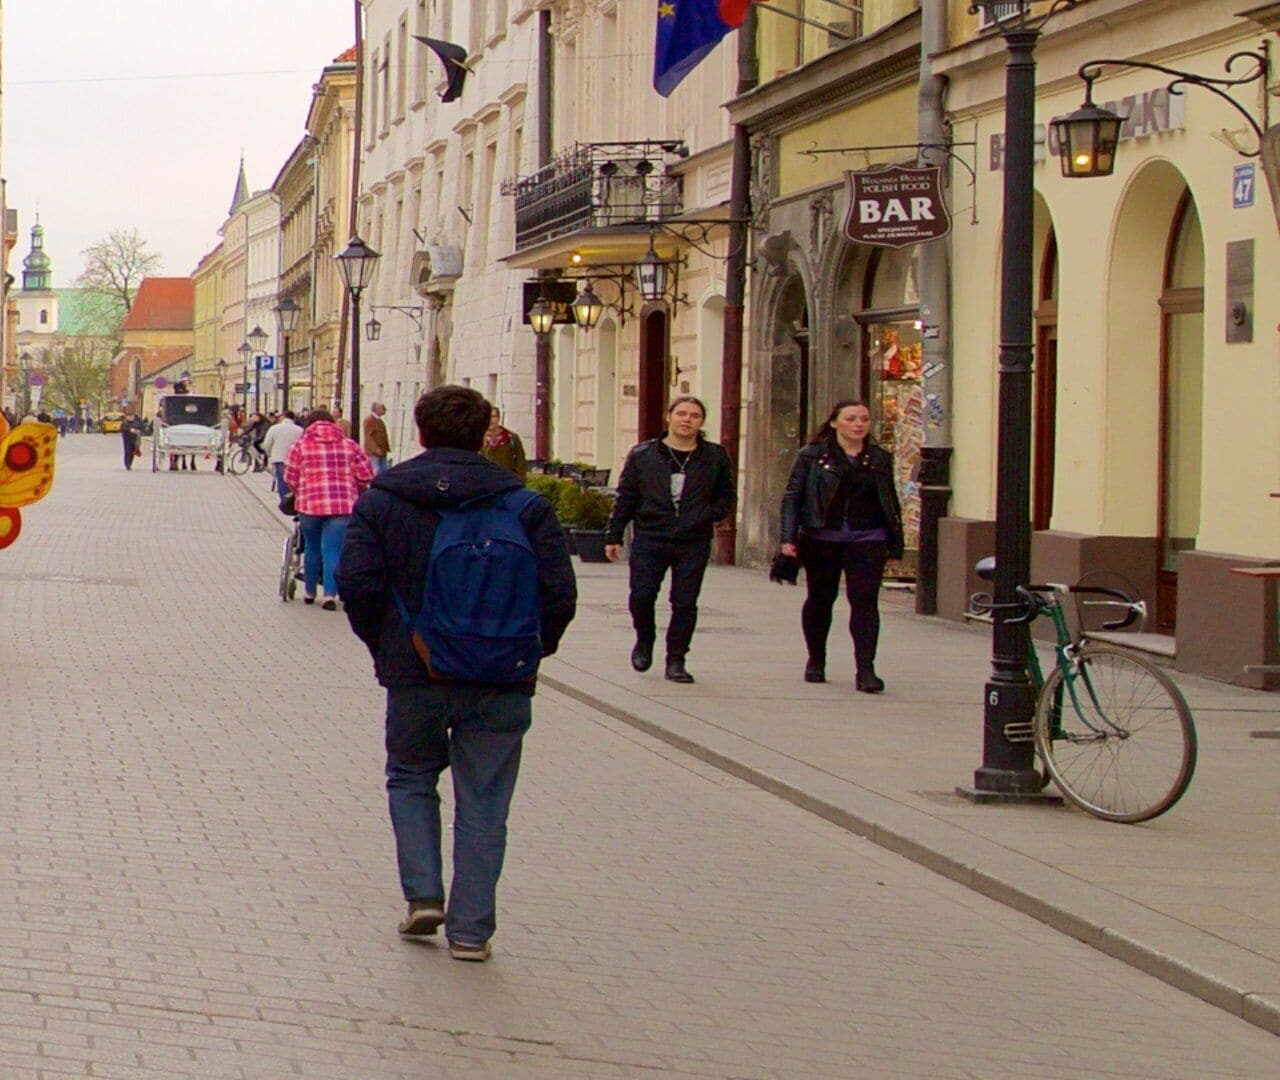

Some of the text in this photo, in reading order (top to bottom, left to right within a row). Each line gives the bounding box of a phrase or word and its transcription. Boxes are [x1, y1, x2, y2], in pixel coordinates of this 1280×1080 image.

[901, 182, 930, 191] FOOD
[1235, 178, 1252, 201] 47
[859, 197, 936, 224] BAR
[989, 691, 998, 706] 6
